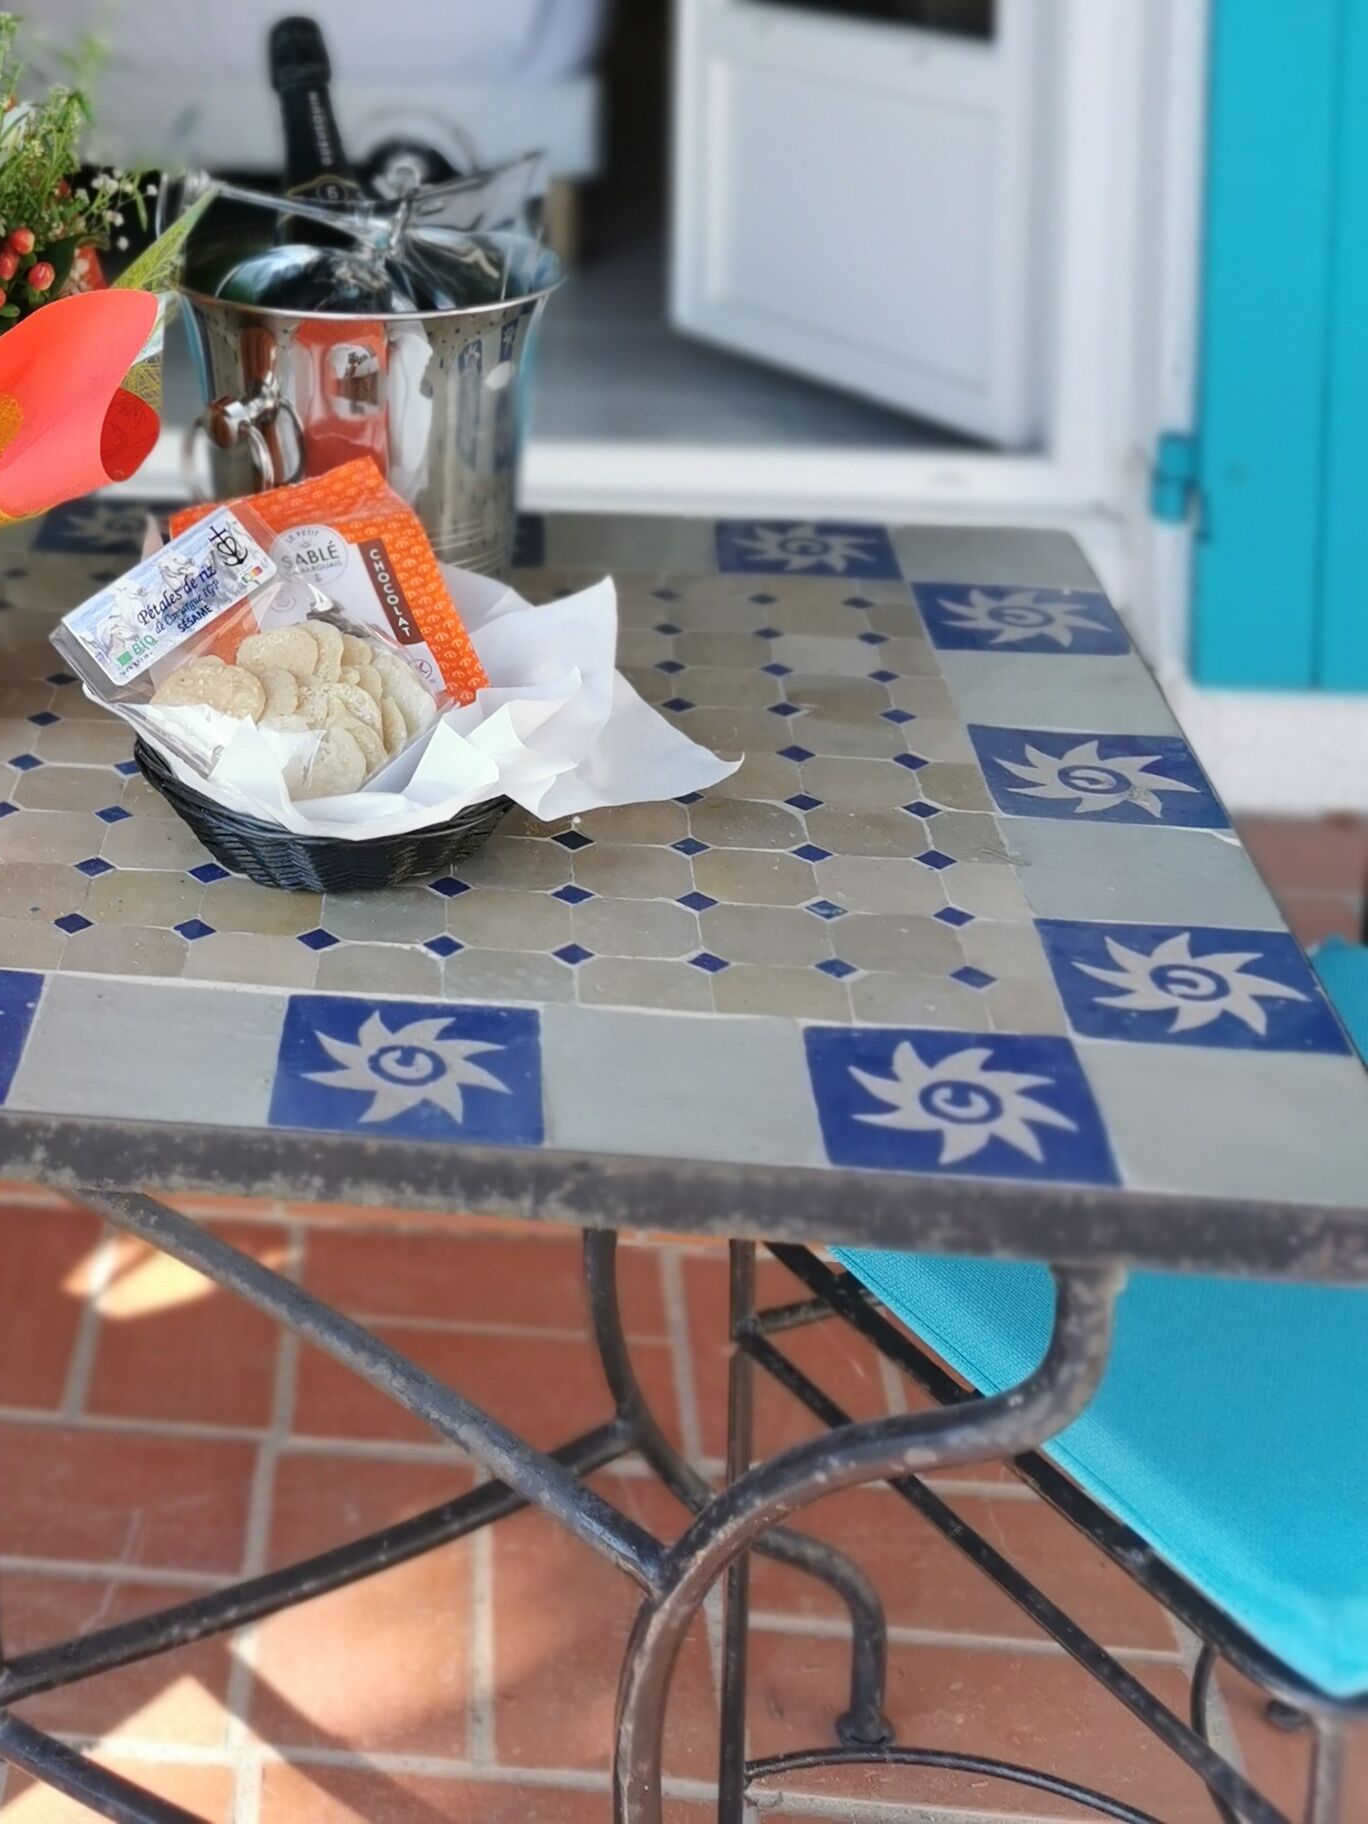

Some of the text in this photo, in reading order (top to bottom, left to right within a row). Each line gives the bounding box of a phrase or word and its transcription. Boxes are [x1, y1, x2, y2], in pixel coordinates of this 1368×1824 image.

[295, 529, 320, 537] PETIT
[281, 540, 340, 570] SABLÉ
[137, 563, 217, 626] Pétales de riz
[368, 548, 412, 637] CHOCOLAT
[155, 619, 166, 634] de
[177, 605, 213, 633] SÉSAME
